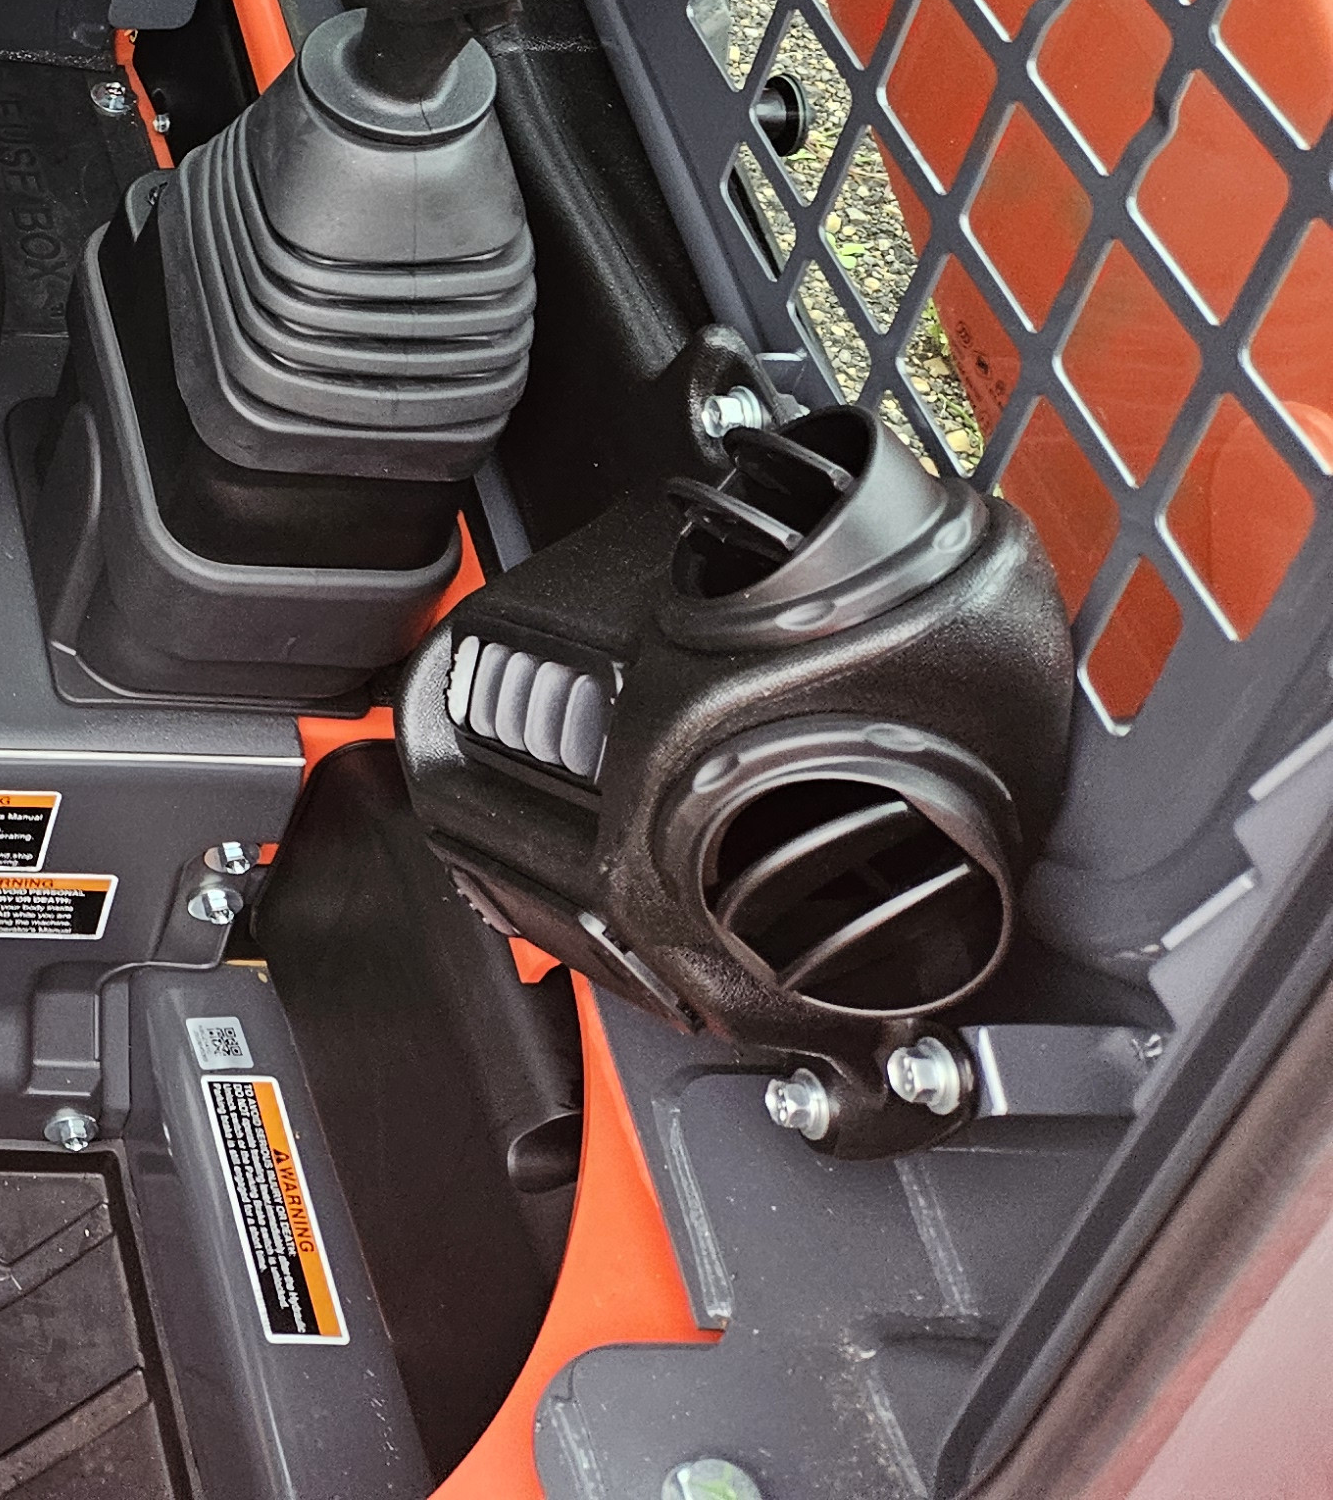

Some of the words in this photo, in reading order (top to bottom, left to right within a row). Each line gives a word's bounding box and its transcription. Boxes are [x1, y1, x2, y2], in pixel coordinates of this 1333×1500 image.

[11, 206, 69, 282] BOX
[7, 813, 43, 821] Manual
[279, 1167, 314, 1252] WARNING
